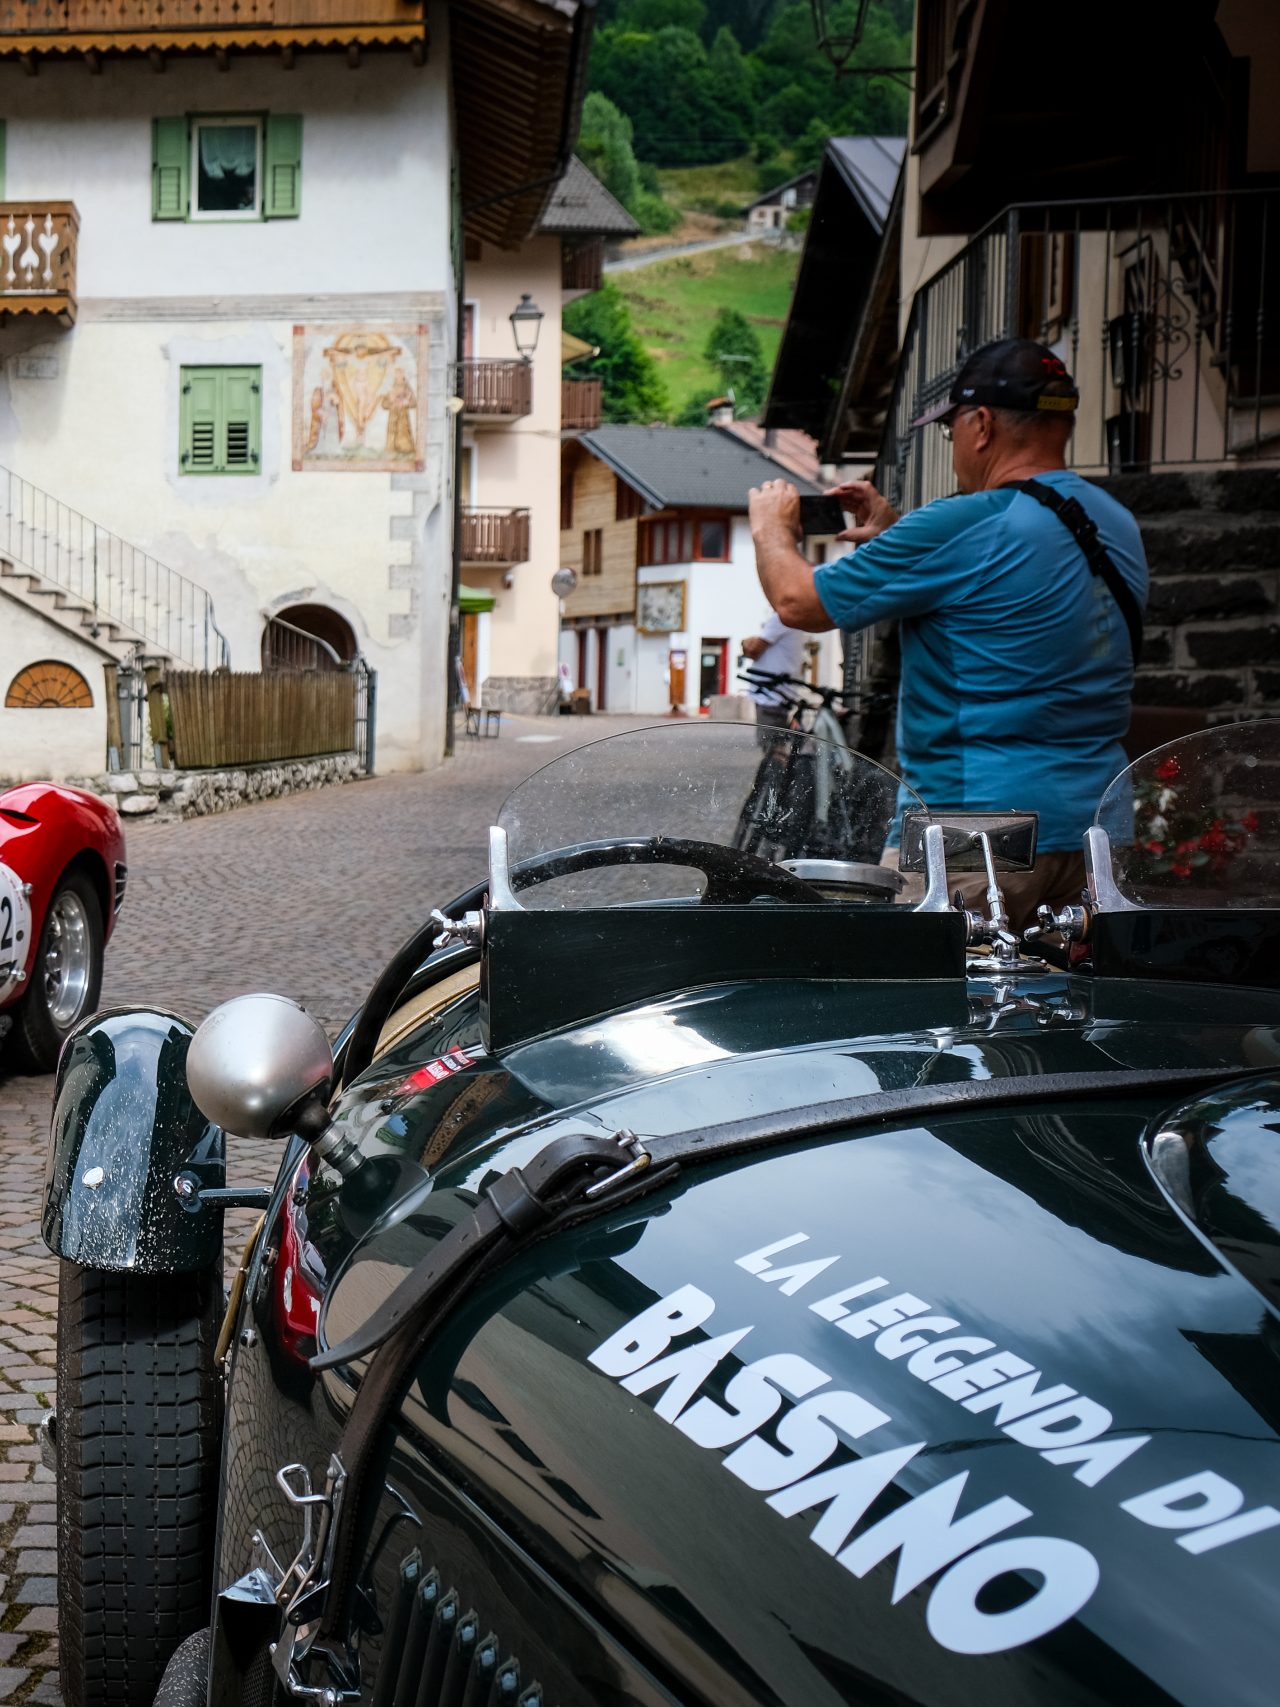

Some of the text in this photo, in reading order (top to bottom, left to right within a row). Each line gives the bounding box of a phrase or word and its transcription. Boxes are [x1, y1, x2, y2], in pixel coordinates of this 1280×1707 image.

[587, 1284, 1100, 1655] BASSANO
[734, 1232, 1280, 1555] LA LEGGENDA DI
